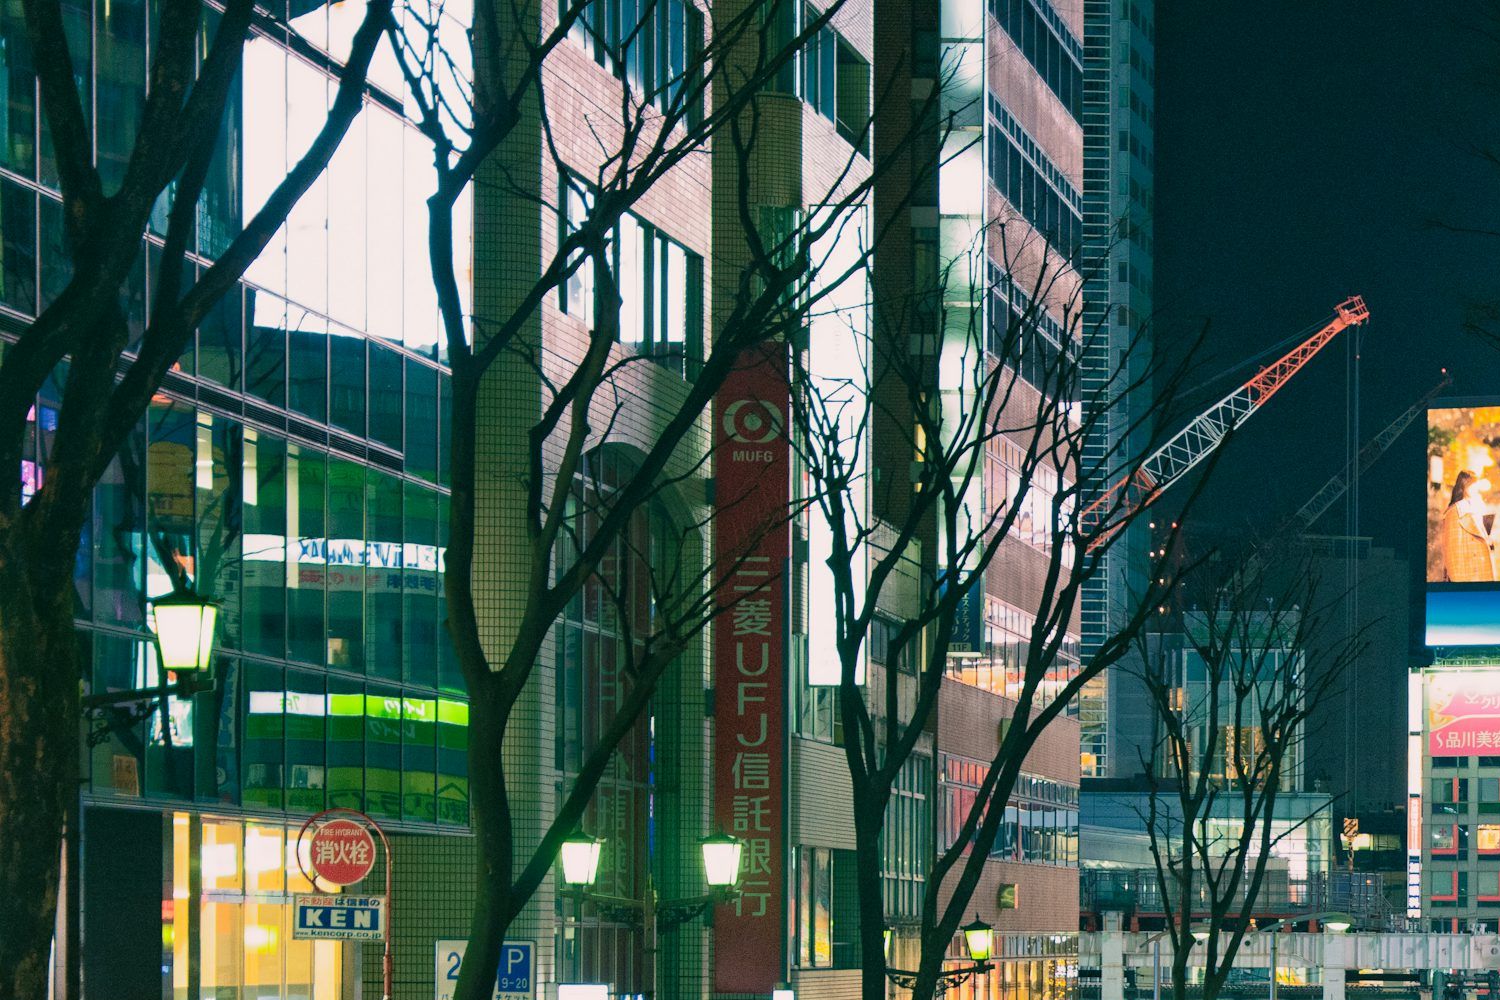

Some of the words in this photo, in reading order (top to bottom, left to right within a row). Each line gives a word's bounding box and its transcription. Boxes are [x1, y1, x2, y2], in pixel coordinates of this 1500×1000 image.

[732, 451, 773, 462] MUFG
[731, 556, 774, 917] 三菱UFJ信託銀行
[320, 828, 334, 836] FIRE
[335, 828, 364, 837] HYDRANT
[315, 840, 370, 865] 消火栓
[298, 897, 381, 907] 不動産は信頼の
[305, 908, 371, 928] KEN
[295, 929, 382, 939] www.kencorp.co.jp
[446, 951, 463, 980] 2
[507, 948, 525, 974] P
[501, 977, 529, 989] 9-20
